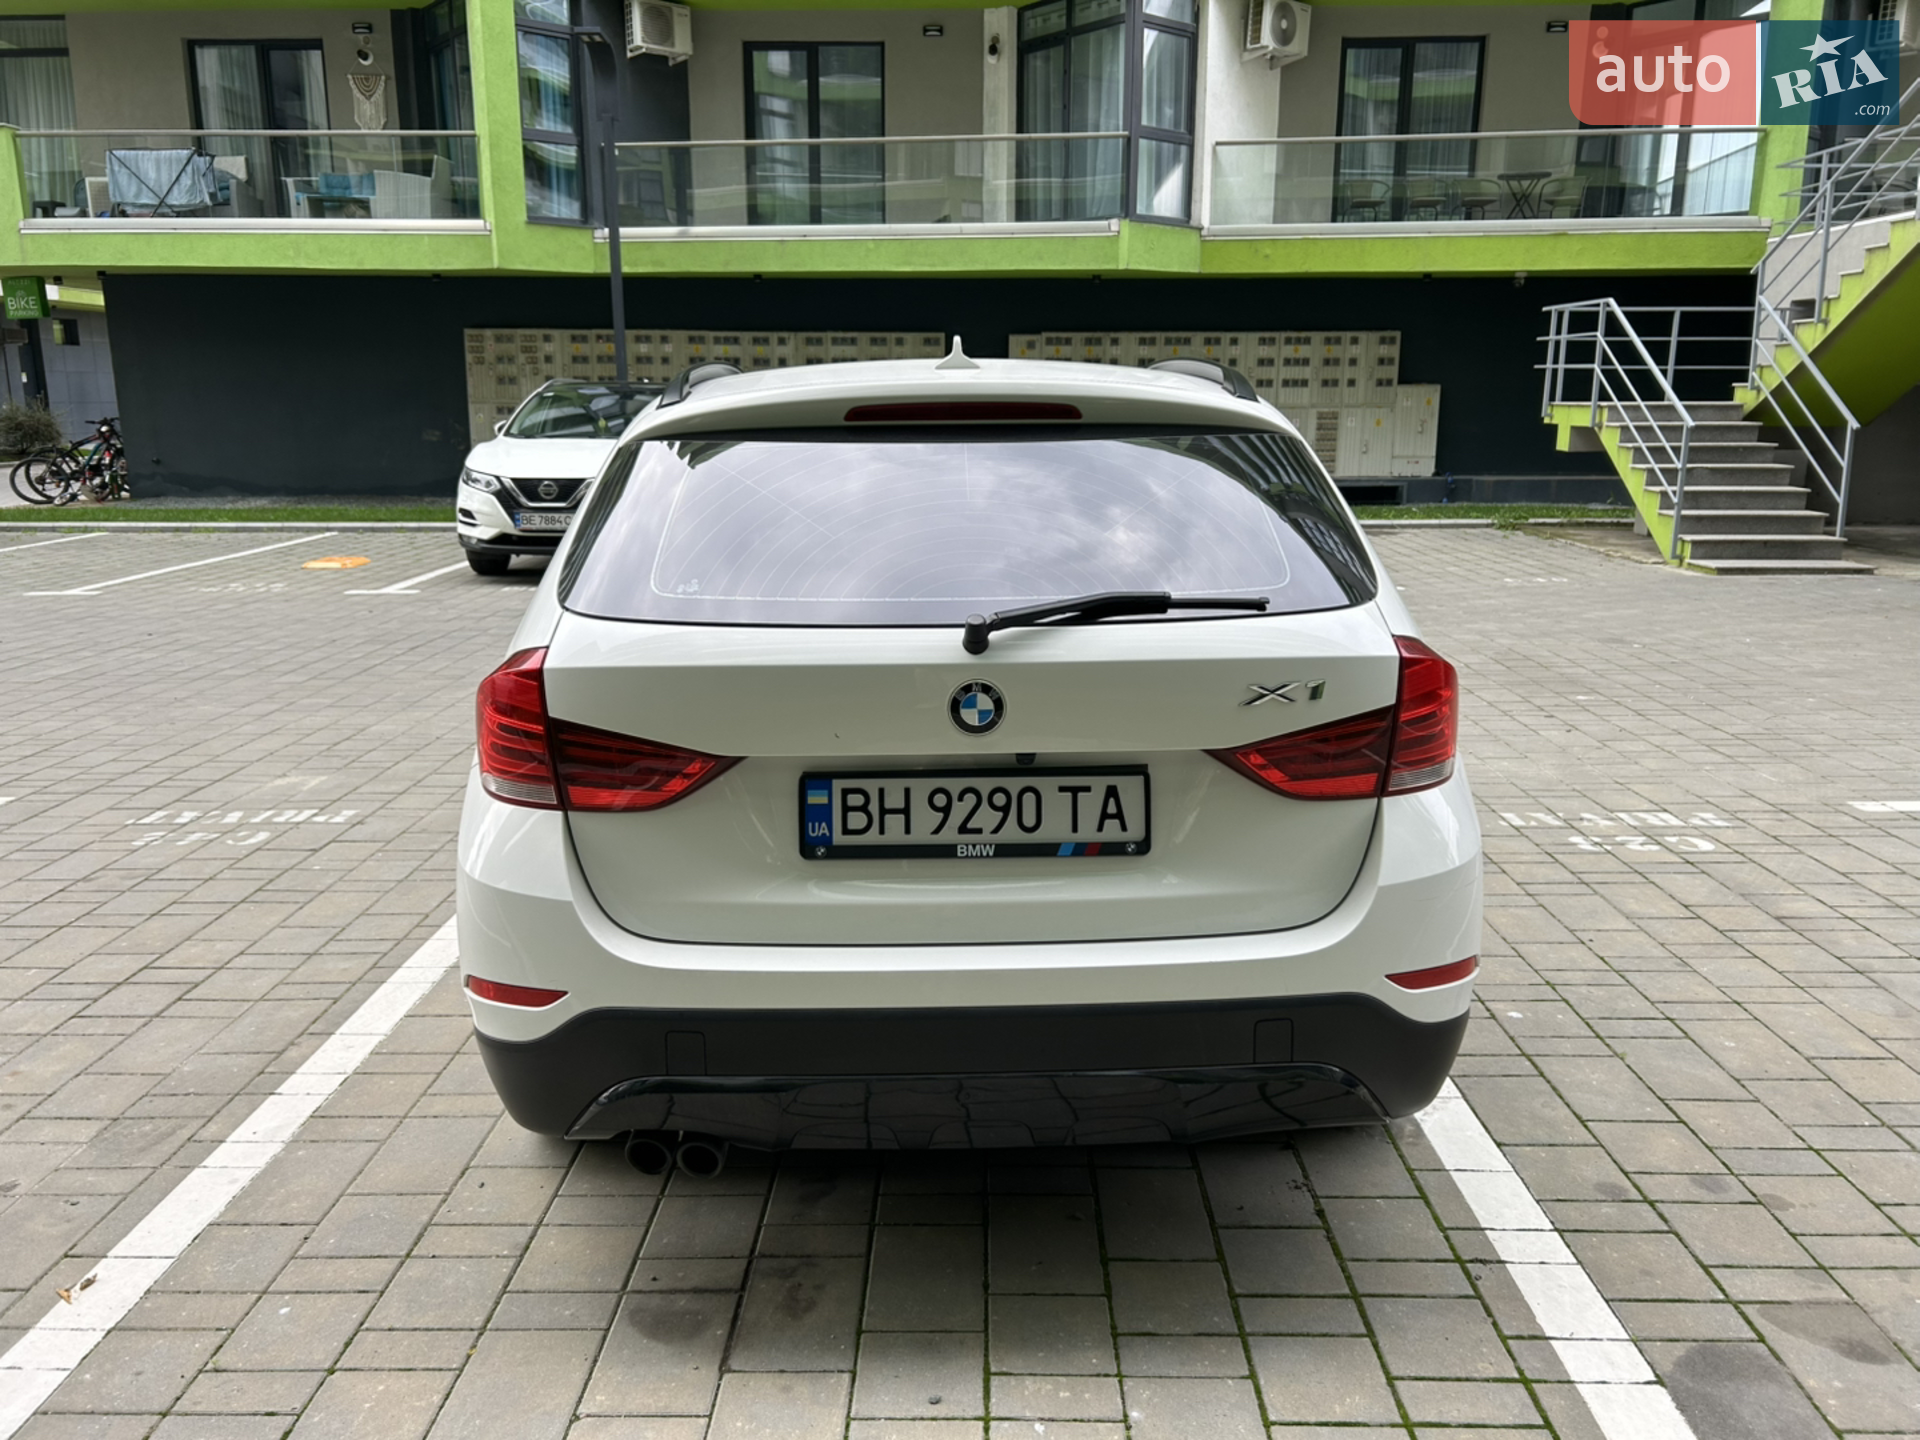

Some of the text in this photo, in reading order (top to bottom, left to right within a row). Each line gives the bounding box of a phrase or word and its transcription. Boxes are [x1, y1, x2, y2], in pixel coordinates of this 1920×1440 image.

[7, 296, 38, 310] BIKE
[520, 515, 538, 526] BE
[538, 515, 562, 526] 7884
[563, 515, 573, 526] C
[953, 682, 1002, 701] BMW
[1238, 679, 1327, 706] X1
[125, 810, 361, 824] PRIVAT
[840, 784, 1129, 836] BH 9290 TA
[1498, 812, 1733, 826] PRIVAT
[808, 821, 830, 837] UA
[956, 843, 996, 857] BMW
